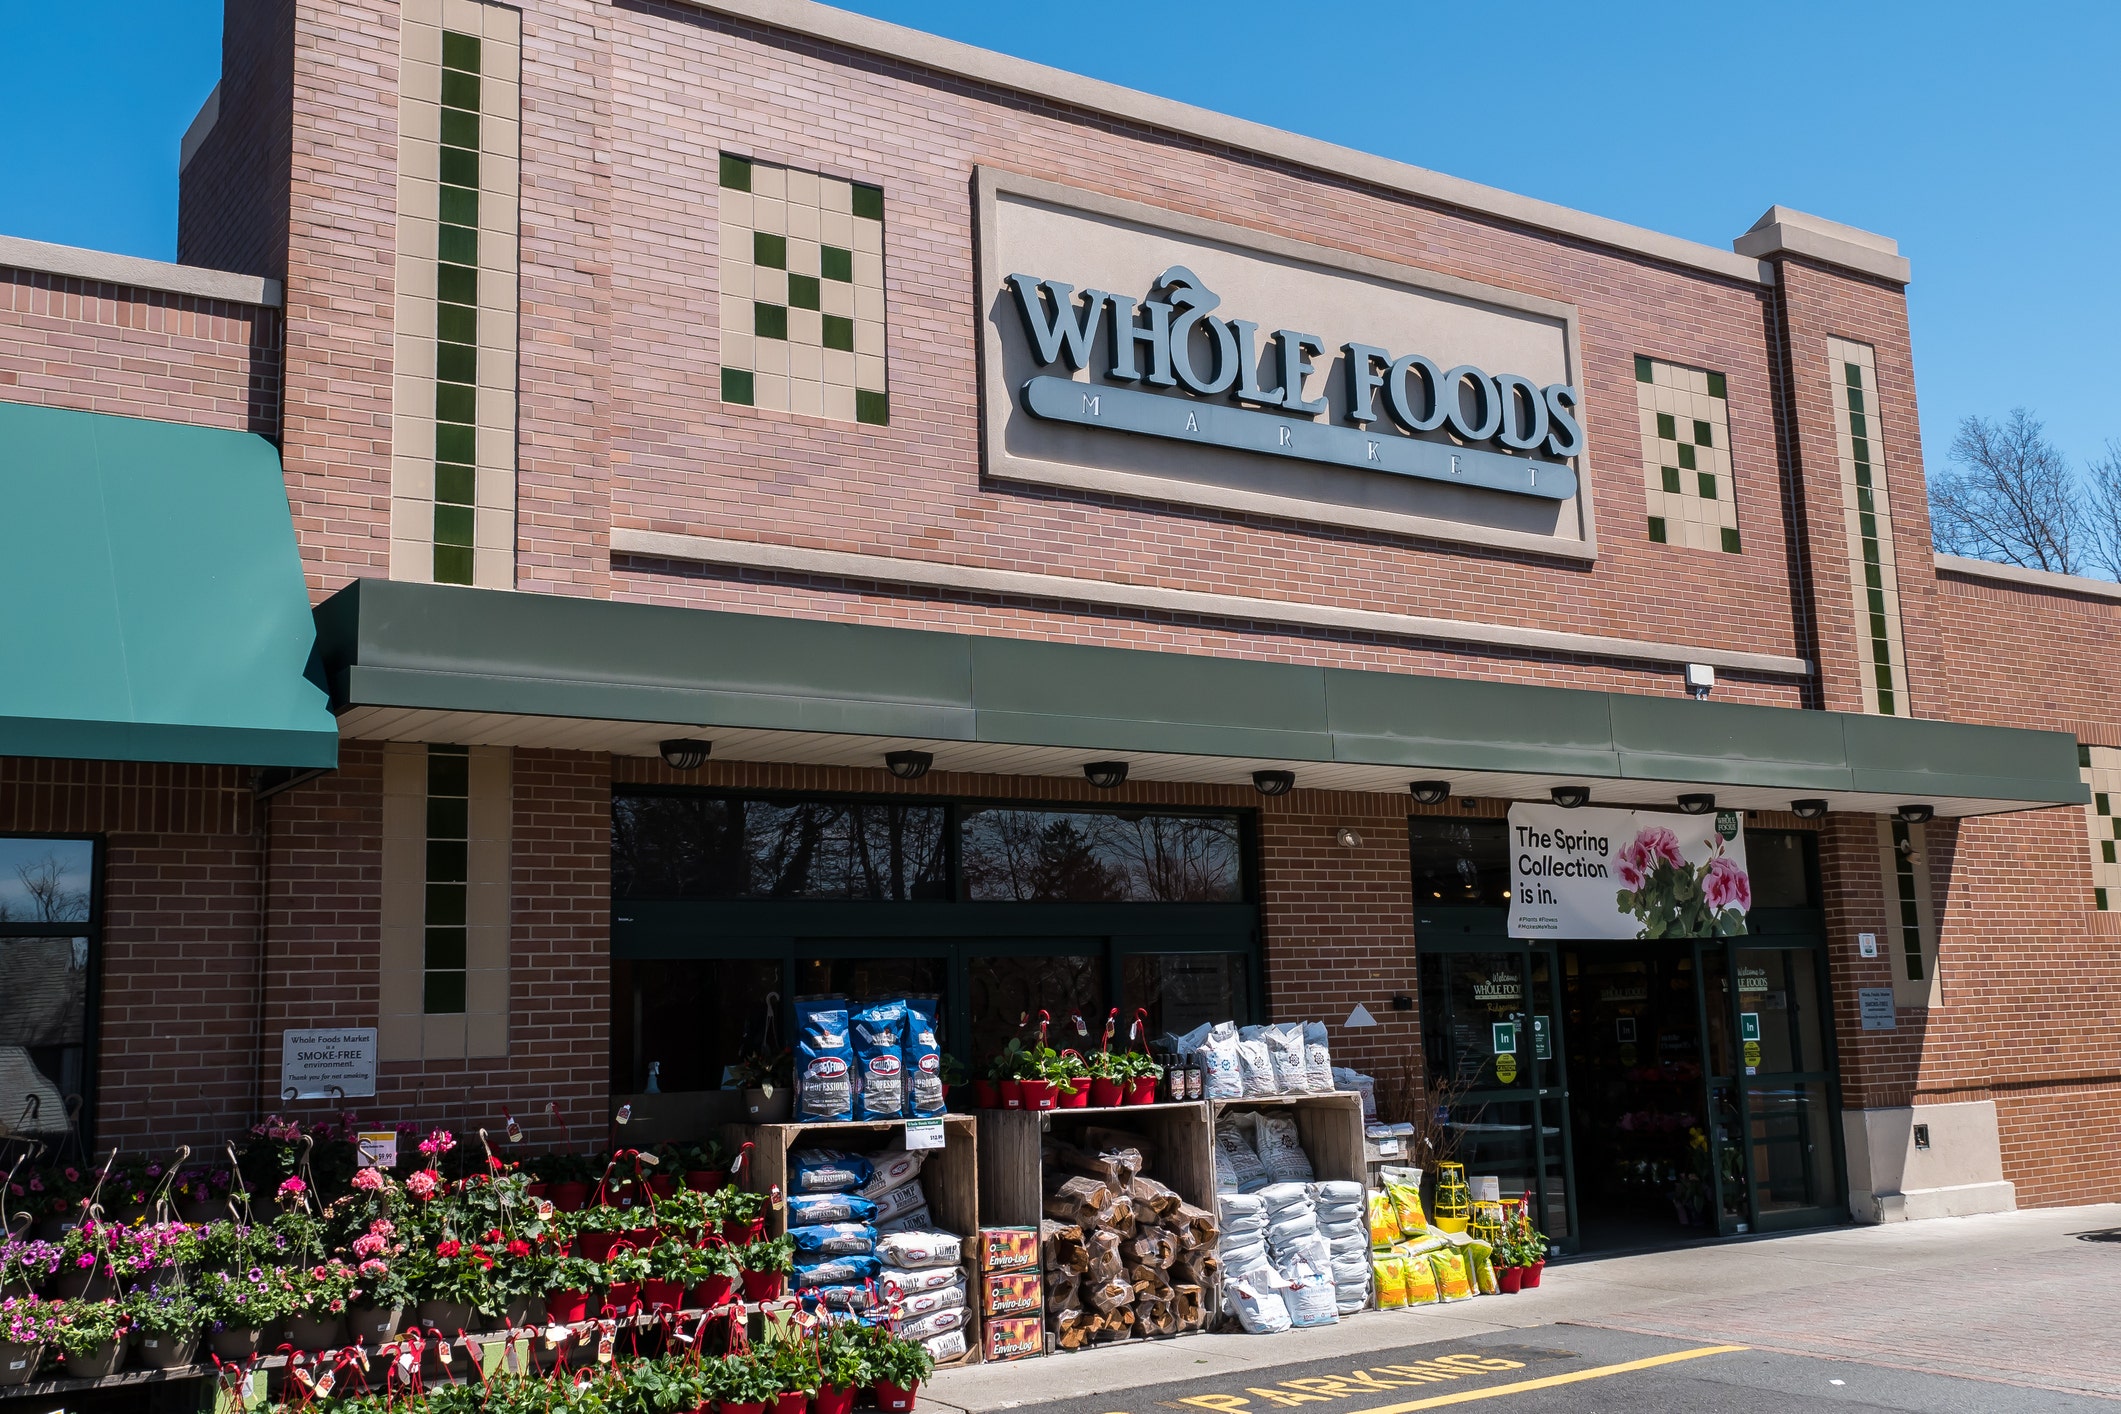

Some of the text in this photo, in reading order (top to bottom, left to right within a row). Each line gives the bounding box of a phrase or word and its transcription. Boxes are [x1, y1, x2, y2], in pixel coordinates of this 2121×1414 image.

[1004, 266, 1584, 458] WHOLE FOODS
[1081, 392, 1539, 488] MARKET
[1516, 826, 1608, 857] The Spring
[1518, 854, 1608, 879] Collection
[1519, 882, 1557, 905] is in.
[1473, 981, 1501, 995] WHOLE
[1747, 1022, 1754, 1032] In
[291, 1035, 370, 1044] Whole Foods Market
[1500, 1033, 1509, 1043] In
[297, 1050, 362, 1061] SMOKE-FREE
[303, 1061, 354, 1069] environment.
[320, 1073, 330, 1081] for
[892, 1185, 915, 1203] LUMP
[903, 1214, 926, 1230] LUMP
[934, 1244, 958, 1256] LUMP
[989, 1254, 1029, 1267] Enviro-Log
[992, 1298, 1032, 1310] Enviro-Log
[937, 1335, 961, 1351] LUMP
[993, 1341, 1034, 1355] Enviro-Log
[1178, 1354, 1526, 1414] PARKING
